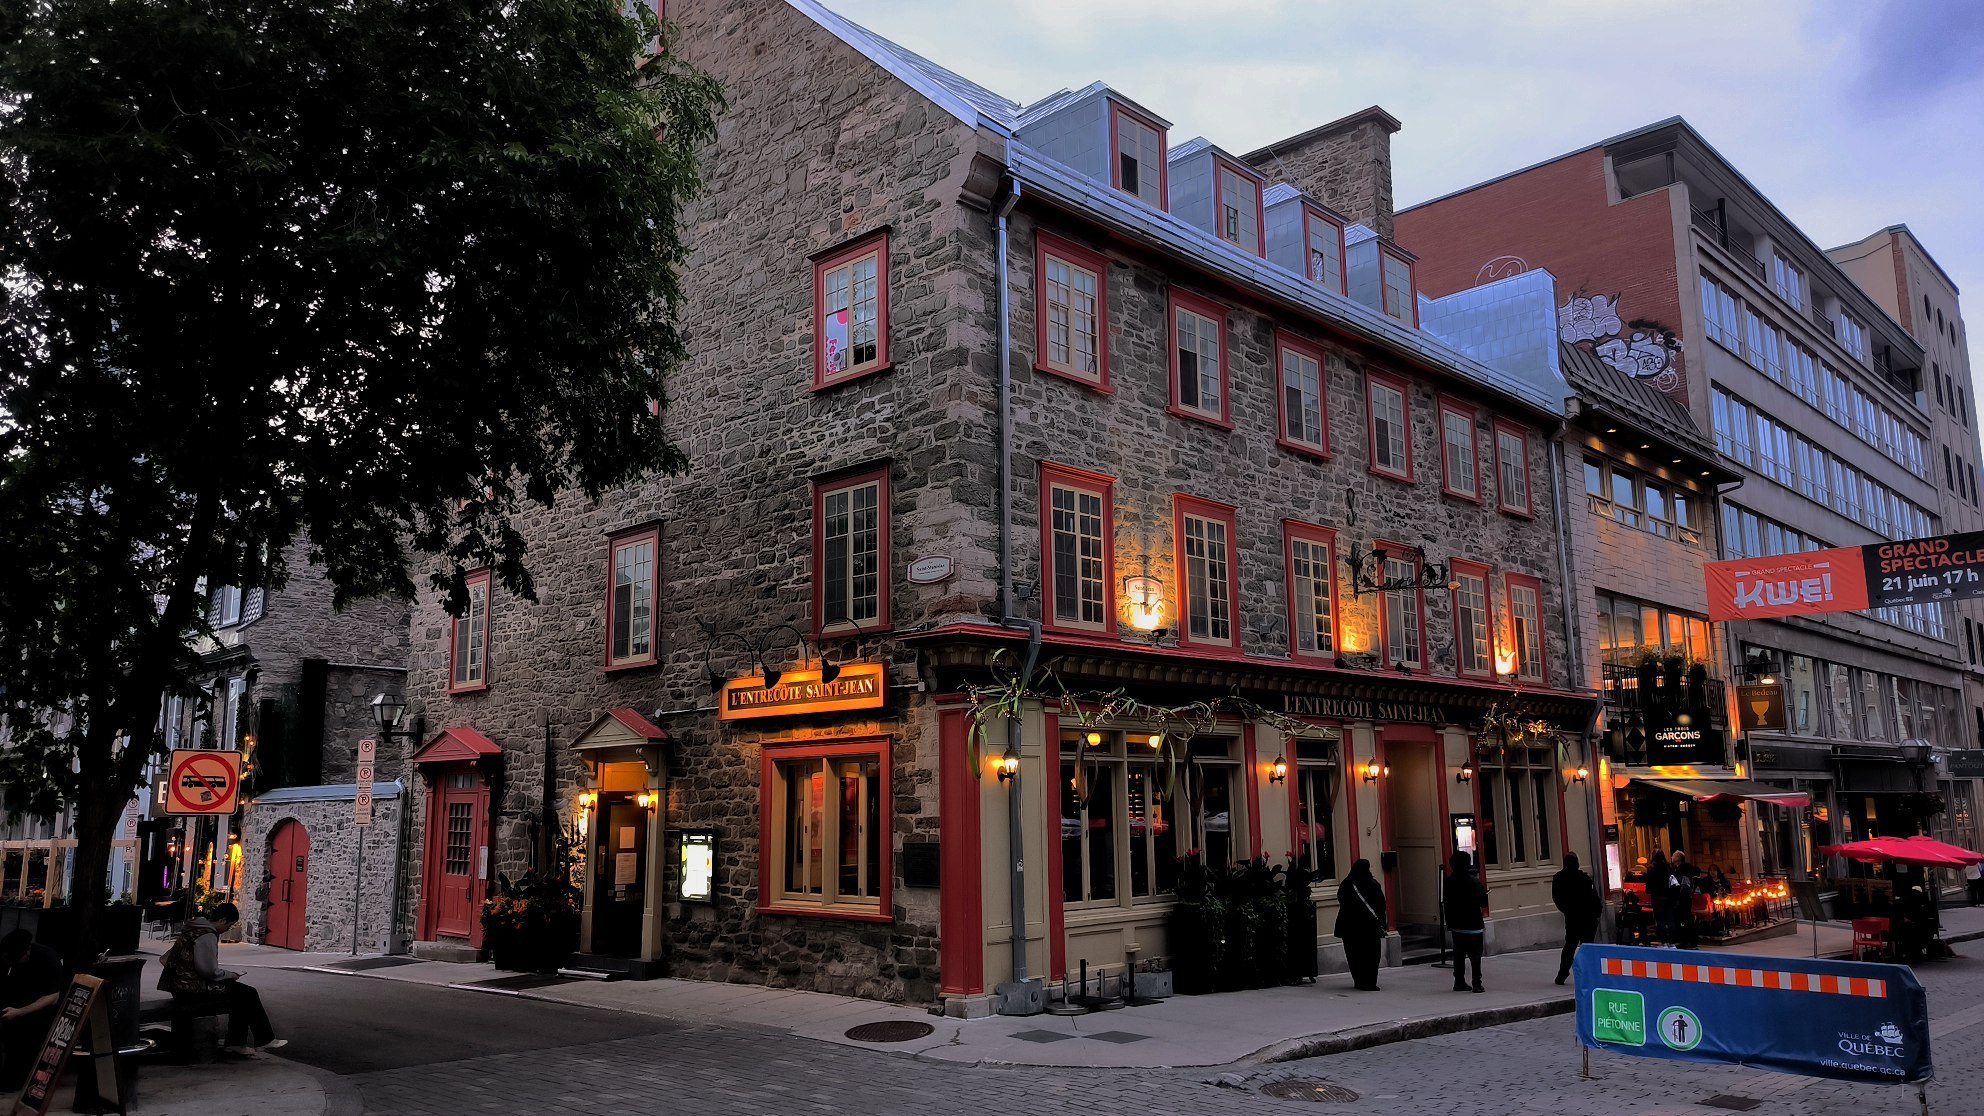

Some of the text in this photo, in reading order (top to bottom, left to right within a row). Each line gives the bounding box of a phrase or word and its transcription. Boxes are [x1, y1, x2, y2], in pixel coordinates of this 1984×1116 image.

[1878, 539, 1949, 559] GRAND
[1751, 563, 1812, 576] GRAND SPECTACLE
[1880, 548, 1984, 573] SPECTACLE
[1882, 568, 1979, 592] 21 juin 17 h
[1733, 573, 1833, 609] KWE!
[731, 678, 875, 706] L'ENTRECÔTE SAINT-JEAN
[1751, 688, 1778, 697] Bedeau
[1284, 694, 1447, 723] L'ENTRECÔTE SAINT-JEAN
[1608, 1001, 1628, 1014] RUE
[1597, 1016, 1641, 1032] PIÉTONNE
[1837, 1031, 1873, 1042] VILLE DE
[1838, 1039, 1905, 1058] QUÉBEC
[1820, 1059, 1906, 1076] ville.quebec.qc.ca
